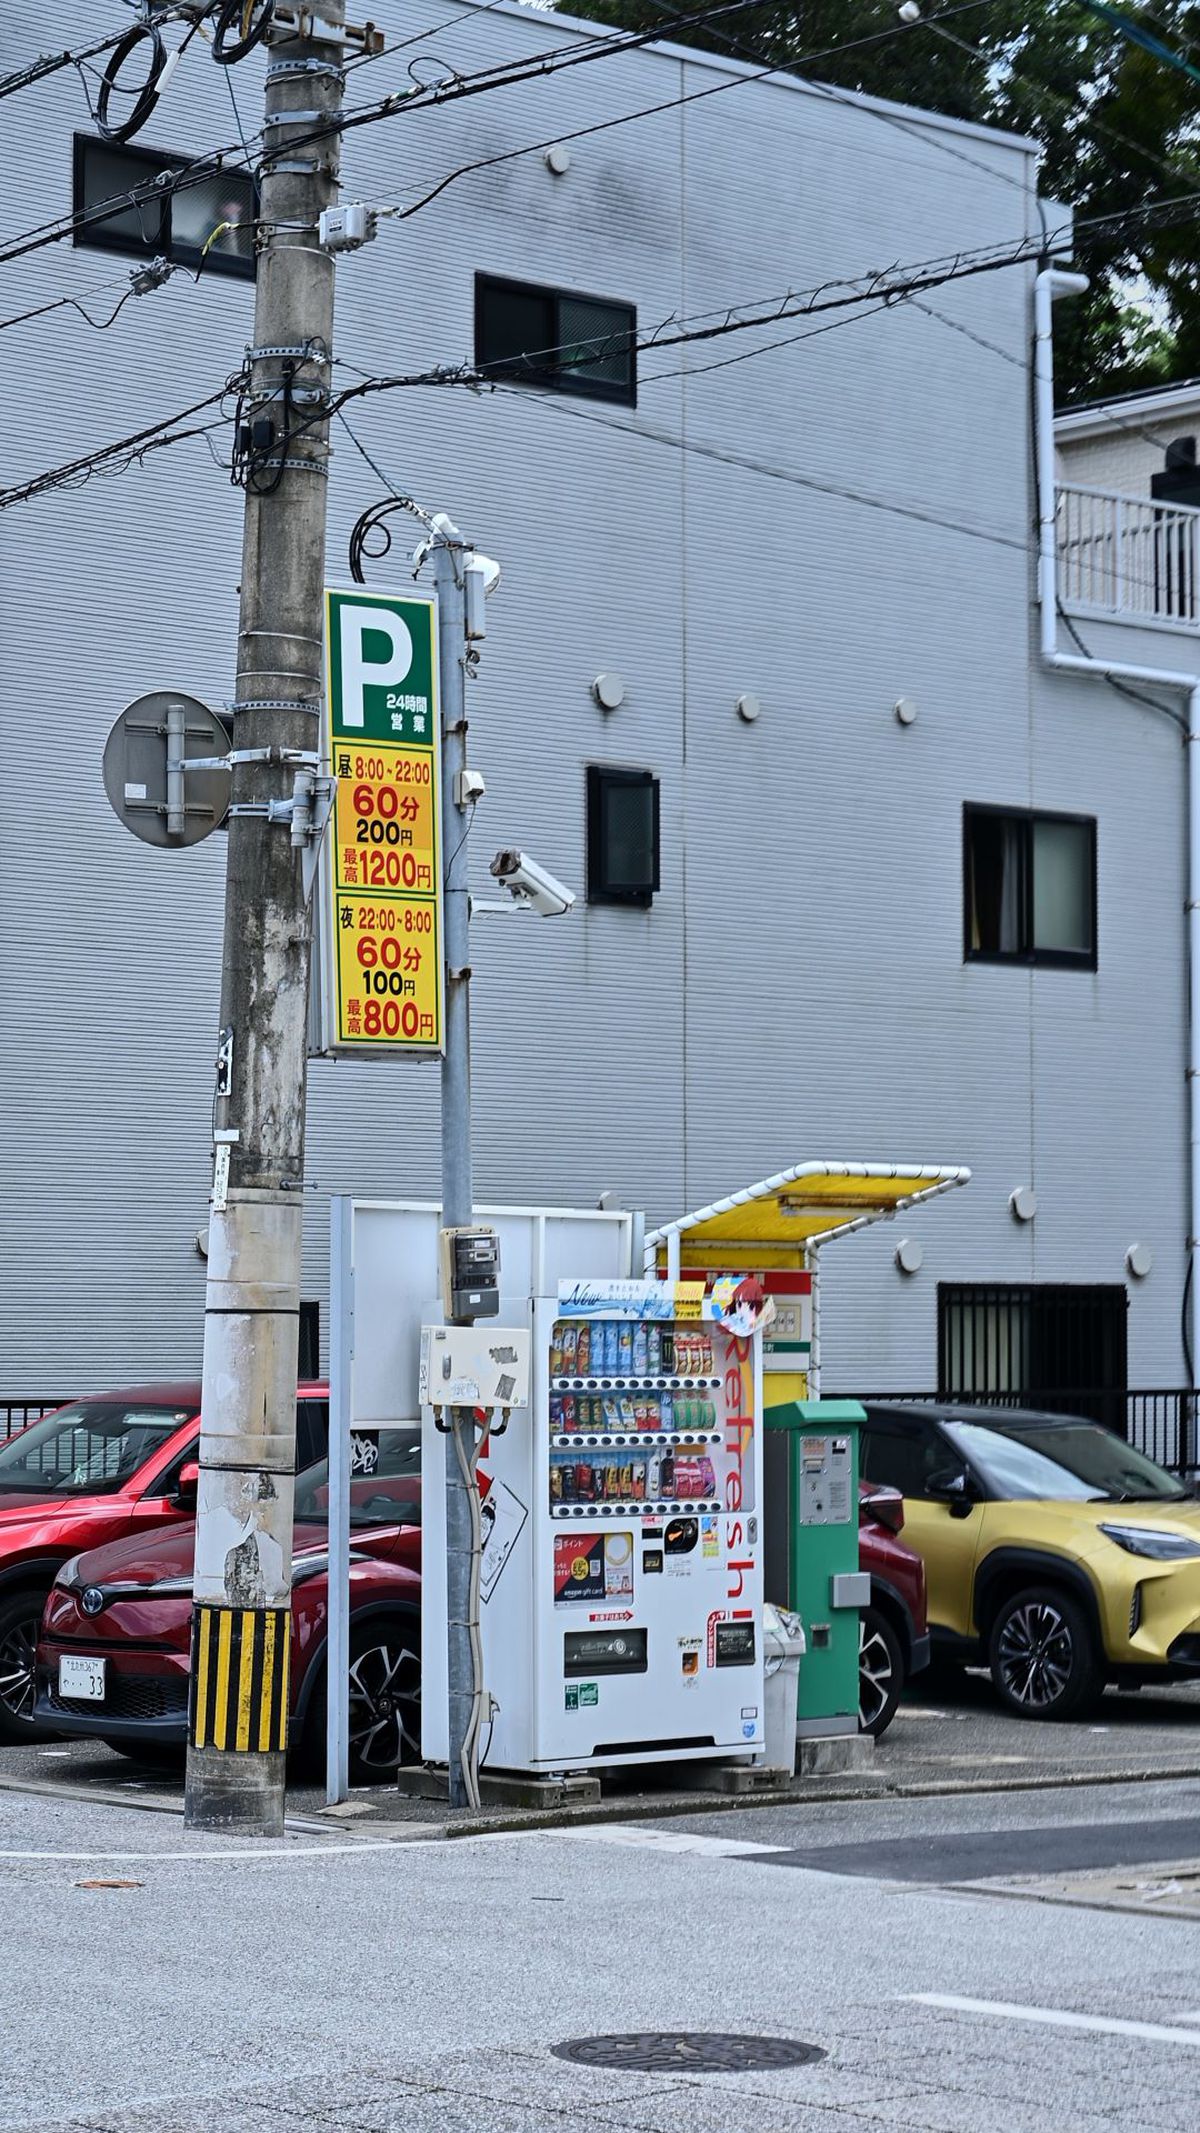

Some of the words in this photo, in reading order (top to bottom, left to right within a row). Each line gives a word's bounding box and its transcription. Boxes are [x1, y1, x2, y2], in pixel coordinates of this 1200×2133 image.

[340, 604, 413, 727] P
[386, 693, 428, 714] 24時間
[391, 713, 425, 733] 営業
[338, 754, 352, 779] 昼
[353, 784, 420, 821] 60分
[356, 818, 413, 846] 200円
[343, 848, 358, 883] 最高
[359, 850, 431, 888] 1200円
[340, 905, 354, 929] 夜
[357, 935, 422, 972] 60分
[362, 970, 416, 996] 100円
[347, 999, 362, 1034] 最高
[363, 999, 434, 1037] 800円
[561, 1284, 600, 1306] New
